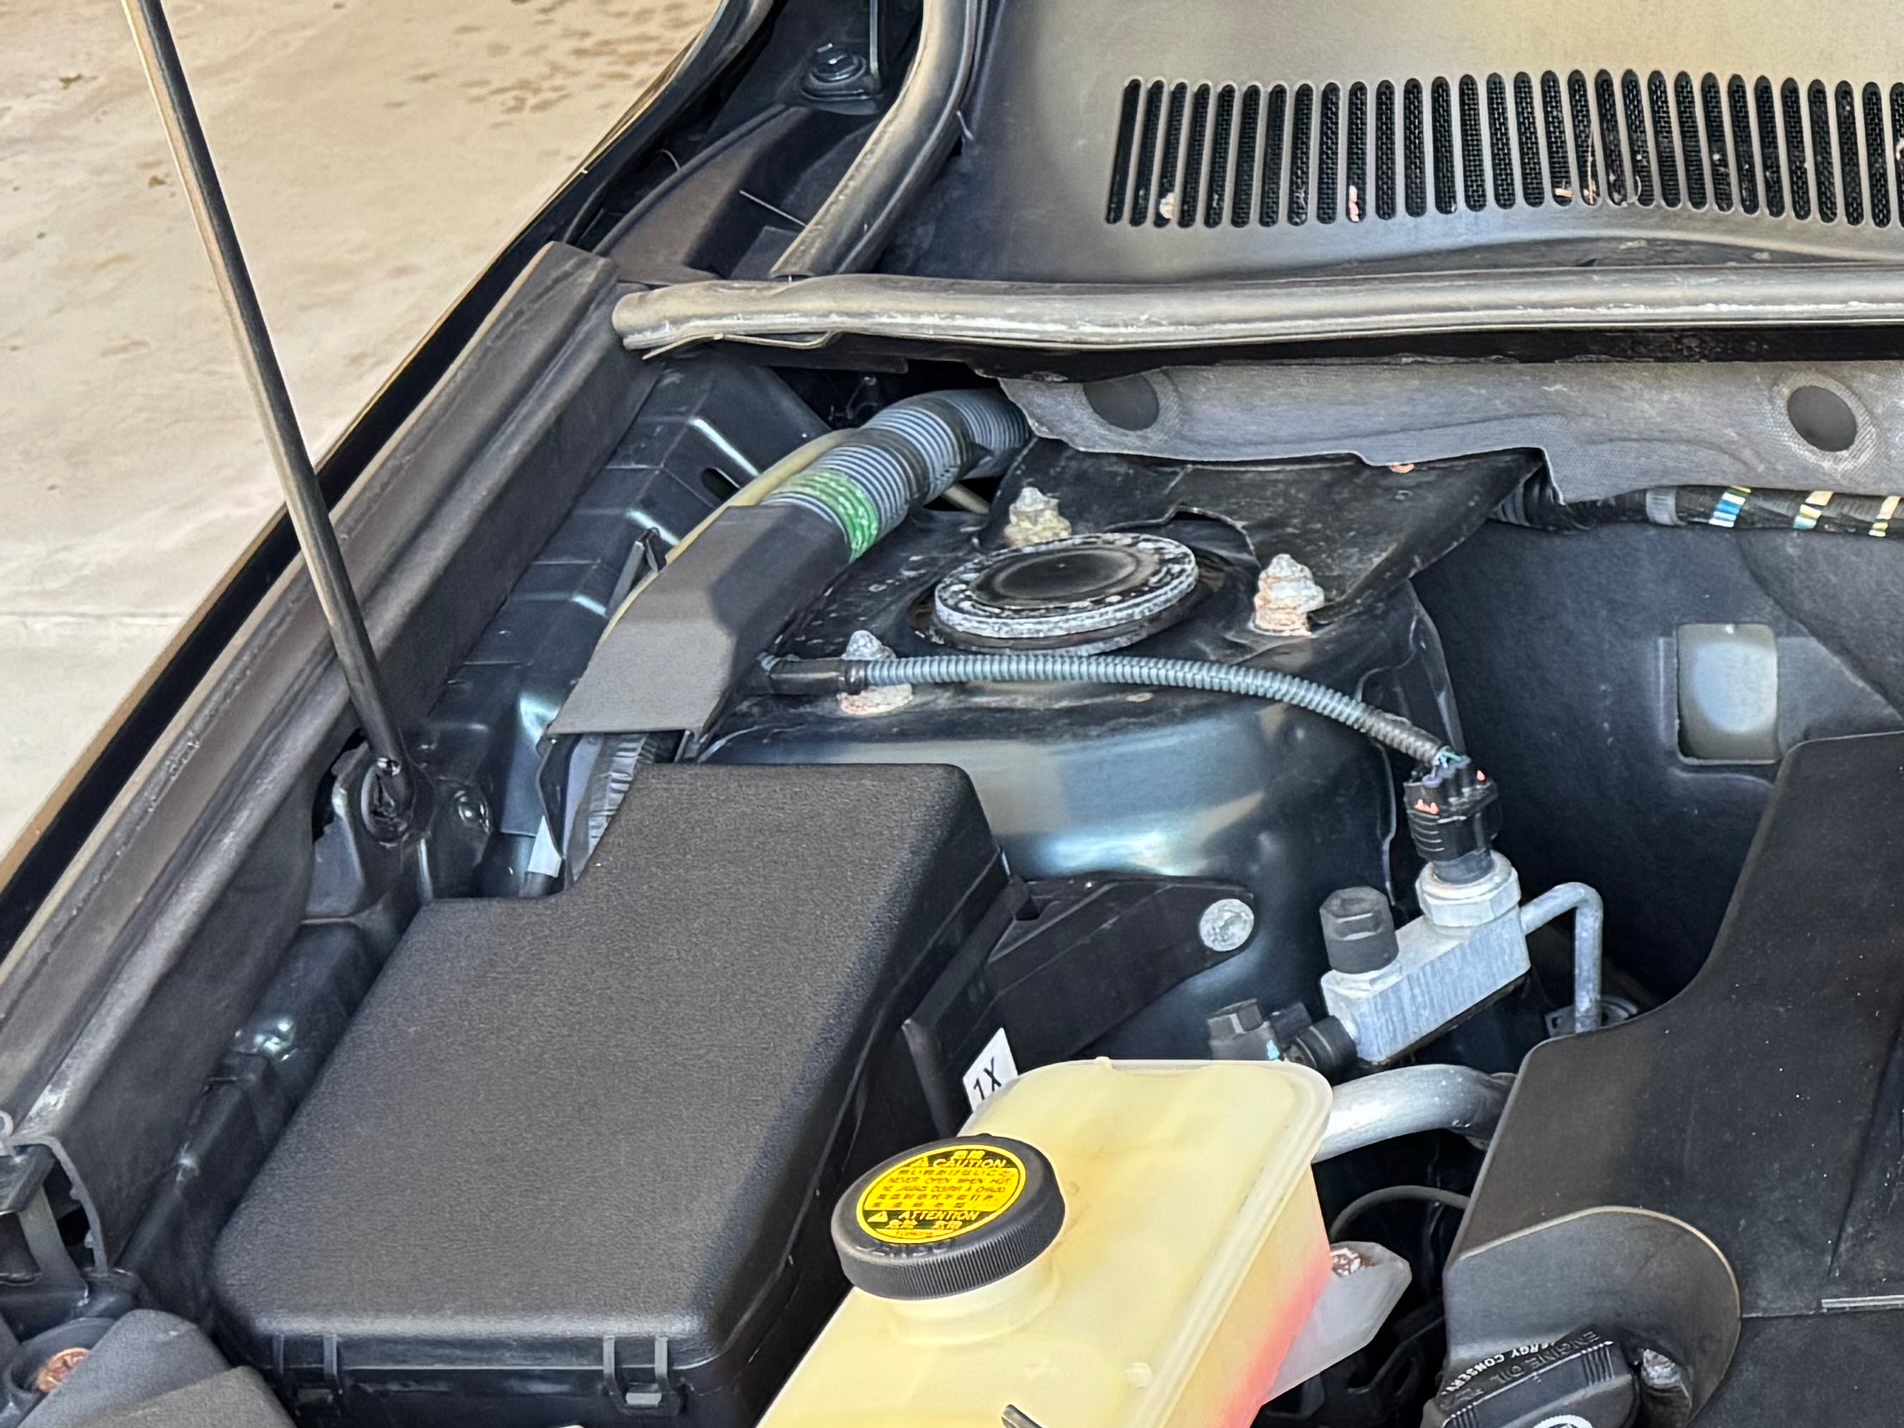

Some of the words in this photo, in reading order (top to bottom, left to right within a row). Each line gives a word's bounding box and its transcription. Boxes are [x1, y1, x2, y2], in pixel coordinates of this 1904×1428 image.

[973, 1057, 1002, 1100] 1X
[933, 1159, 1006, 1168] CAUTION
[898, 1210, 979, 1220] ATTENTION
